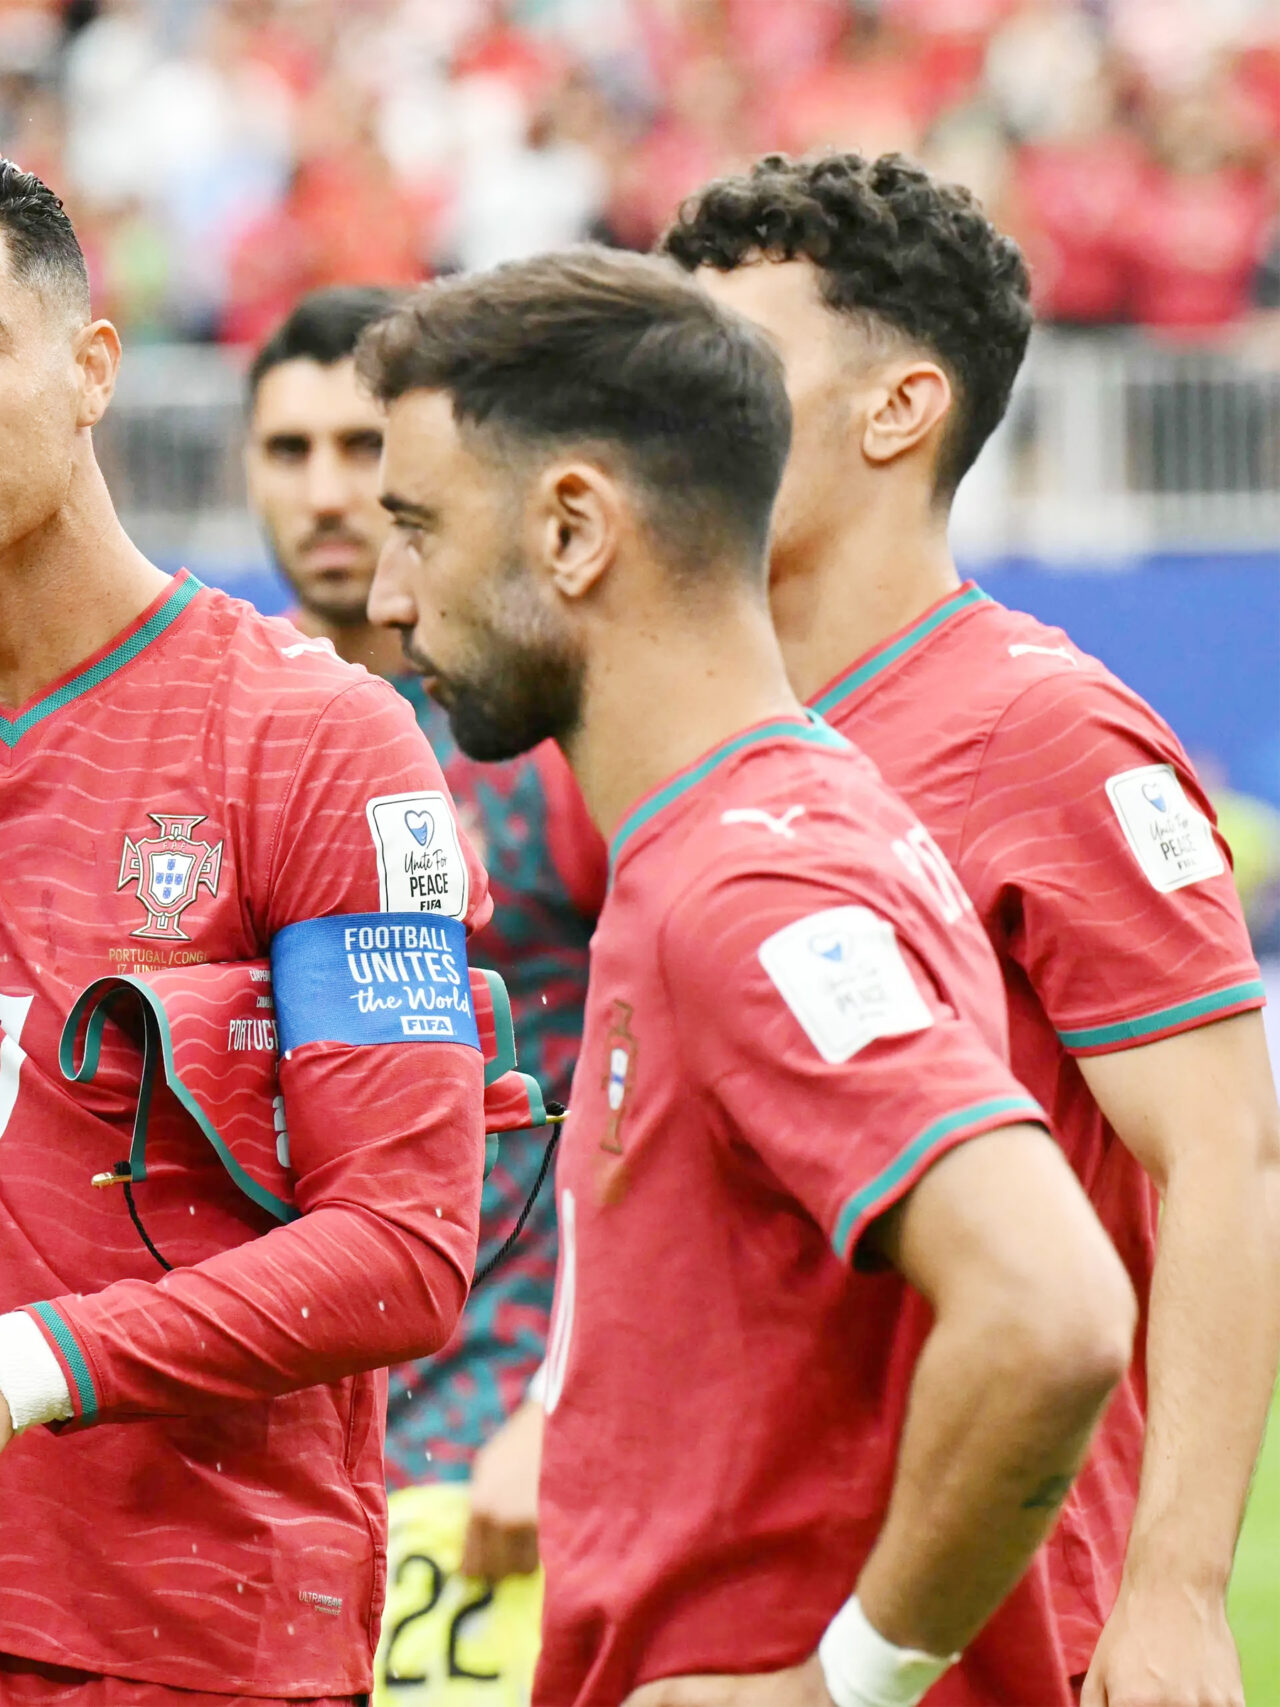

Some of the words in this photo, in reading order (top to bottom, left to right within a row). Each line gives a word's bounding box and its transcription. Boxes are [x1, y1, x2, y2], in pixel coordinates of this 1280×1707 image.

[404, 851, 433, 875] Unite
[432, 848, 448, 871] For
[409, 872, 449, 897] PEACE
[420, 899, 442, 911] FIFA
[344, 926, 453, 952] FOOTBALL
[347, 951, 461, 985] UNITES
[349, 986, 403, 1013] the
[403, 986, 471, 1019] World
[405, 1018, 451, 1033] FIFA
